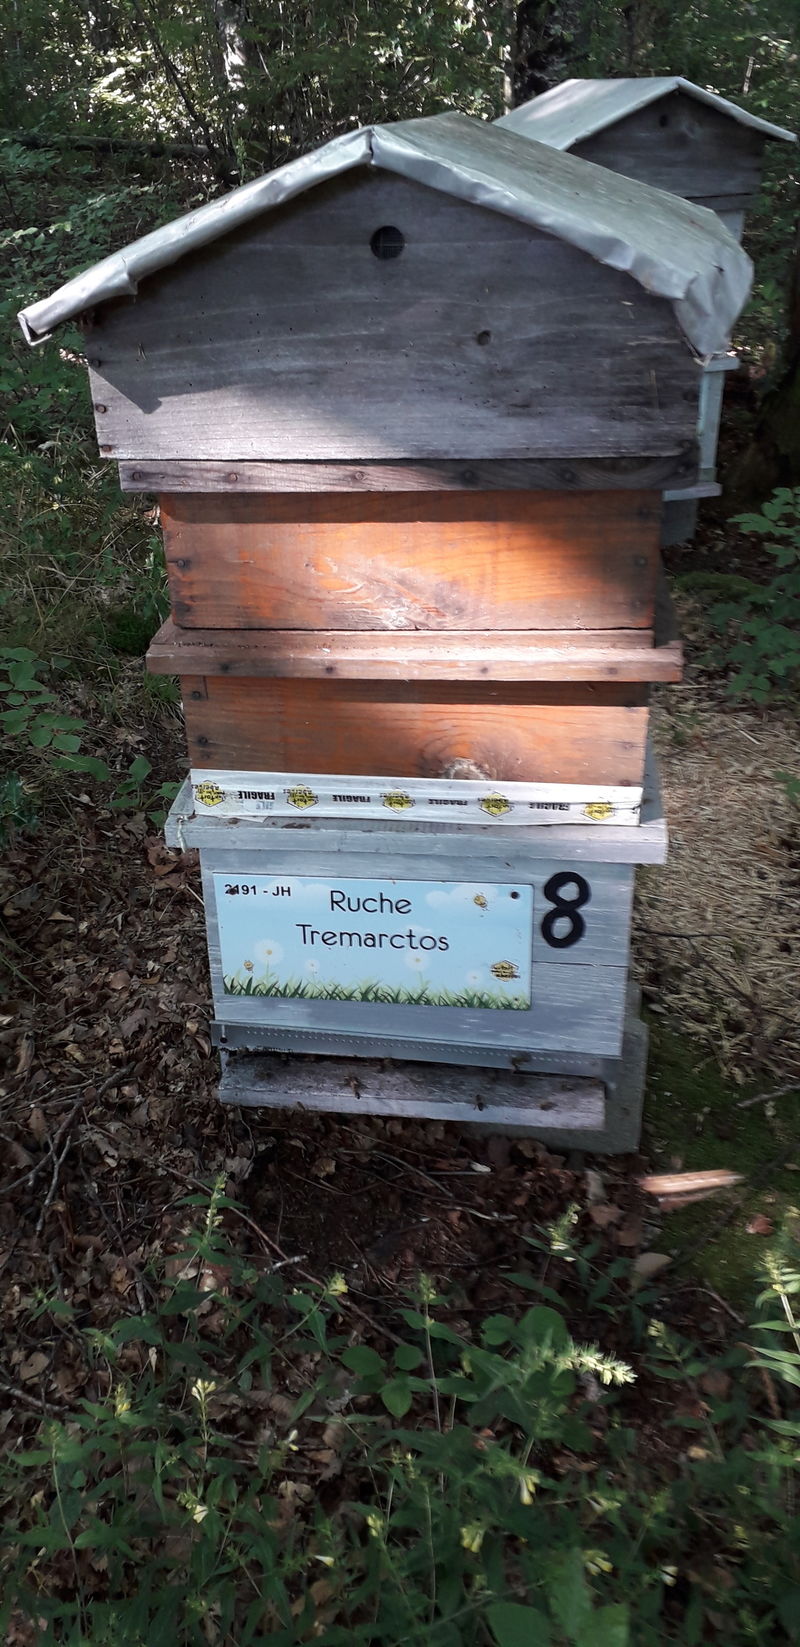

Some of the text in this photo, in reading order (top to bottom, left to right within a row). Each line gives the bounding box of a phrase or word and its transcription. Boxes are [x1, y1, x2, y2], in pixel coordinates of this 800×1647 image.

[237, 790, 275, 801] FRAGILE
[332, 794, 371, 803] FRAGILE
[428, 798, 468, 806] FRAGILE
[272, 886, 291, 897] JH
[329, 889, 413, 915] Ruche
[540, 870, 592, 949] 8
[295, 923, 450, 952] Tremarctos
